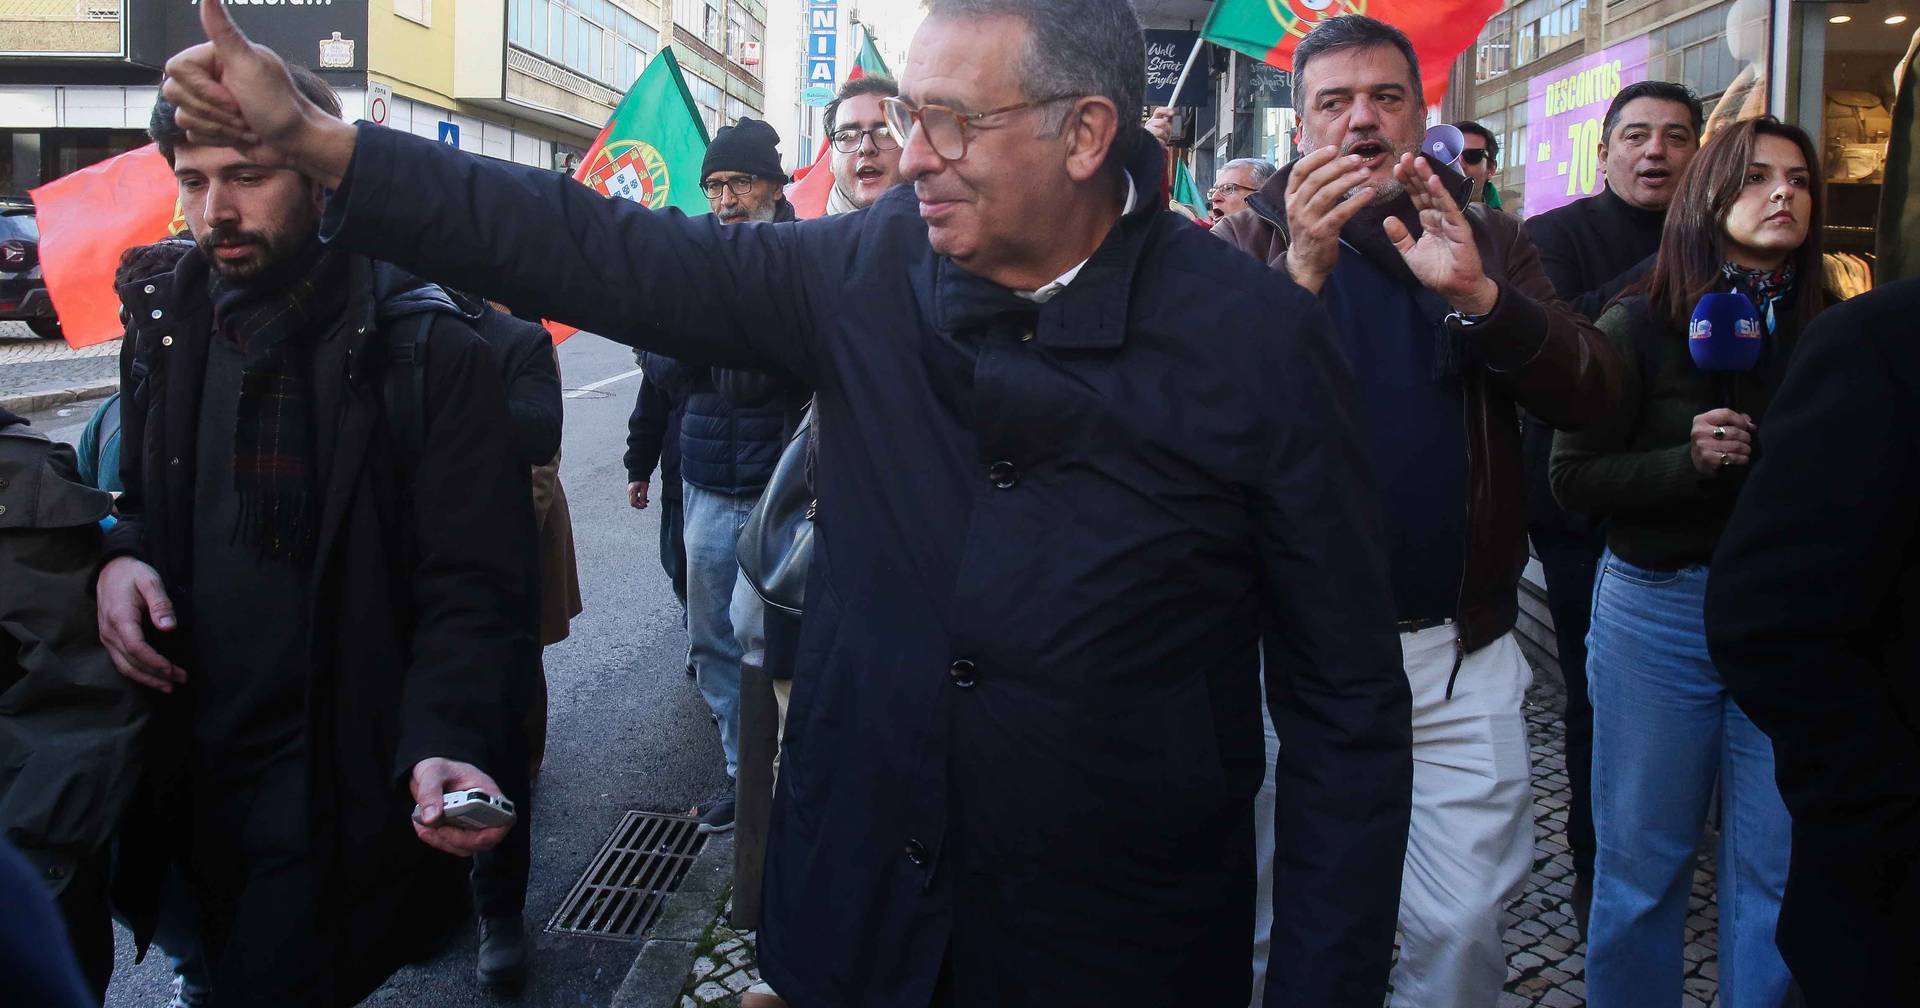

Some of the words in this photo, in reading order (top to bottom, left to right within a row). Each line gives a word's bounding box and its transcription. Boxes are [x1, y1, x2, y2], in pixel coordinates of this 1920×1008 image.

[811, 0, 835, 80] NIA
[1148, 42, 1176, 57] Wall
[1147, 56, 1184, 72] Street
[1147, 72, 1180, 89] Englis
[1545, 60, 1621, 117] DESCONTOS
[1537, 140, 1551, 162] Até
[1558, 116, 1605, 197] -70
